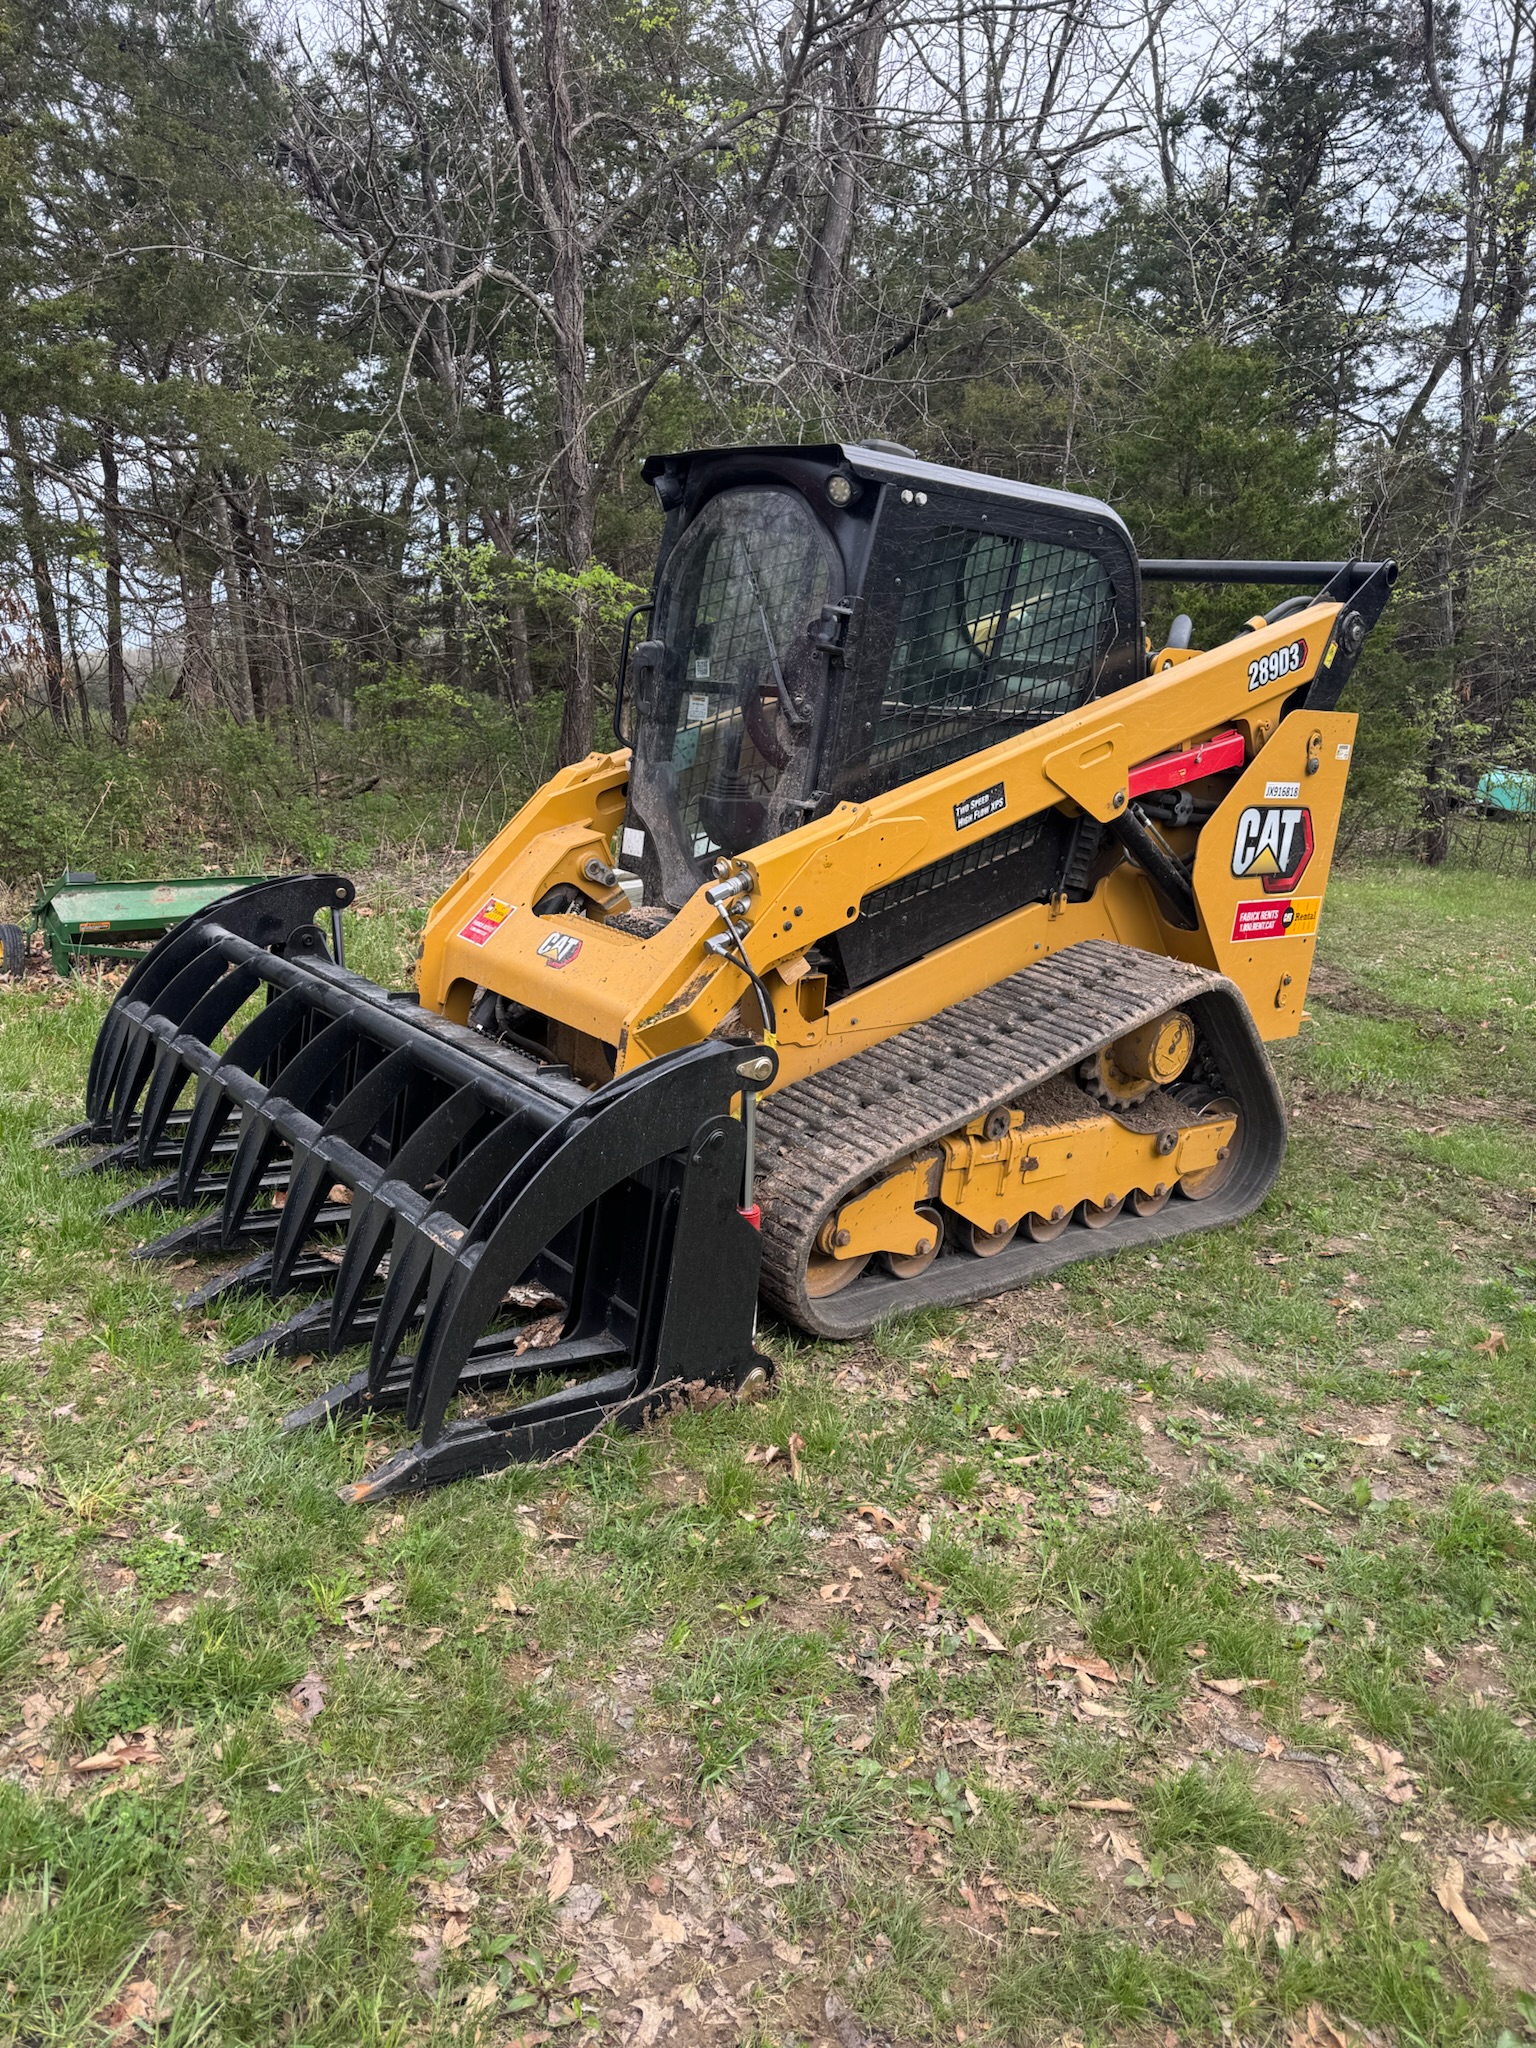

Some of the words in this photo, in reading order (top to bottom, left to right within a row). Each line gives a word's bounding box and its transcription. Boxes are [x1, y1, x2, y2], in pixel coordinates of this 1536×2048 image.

[1248, 642, 1300, 691] 289D3
[955, 803, 970, 817] TWO
[970, 793, 990, 810] SPEED
[990, 797, 1004, 811] XPS
[1232, 808, 1302, 875] CAT
[1294, 911, 1317, 922] Rental
[537, 931, 580, 961] CAT
